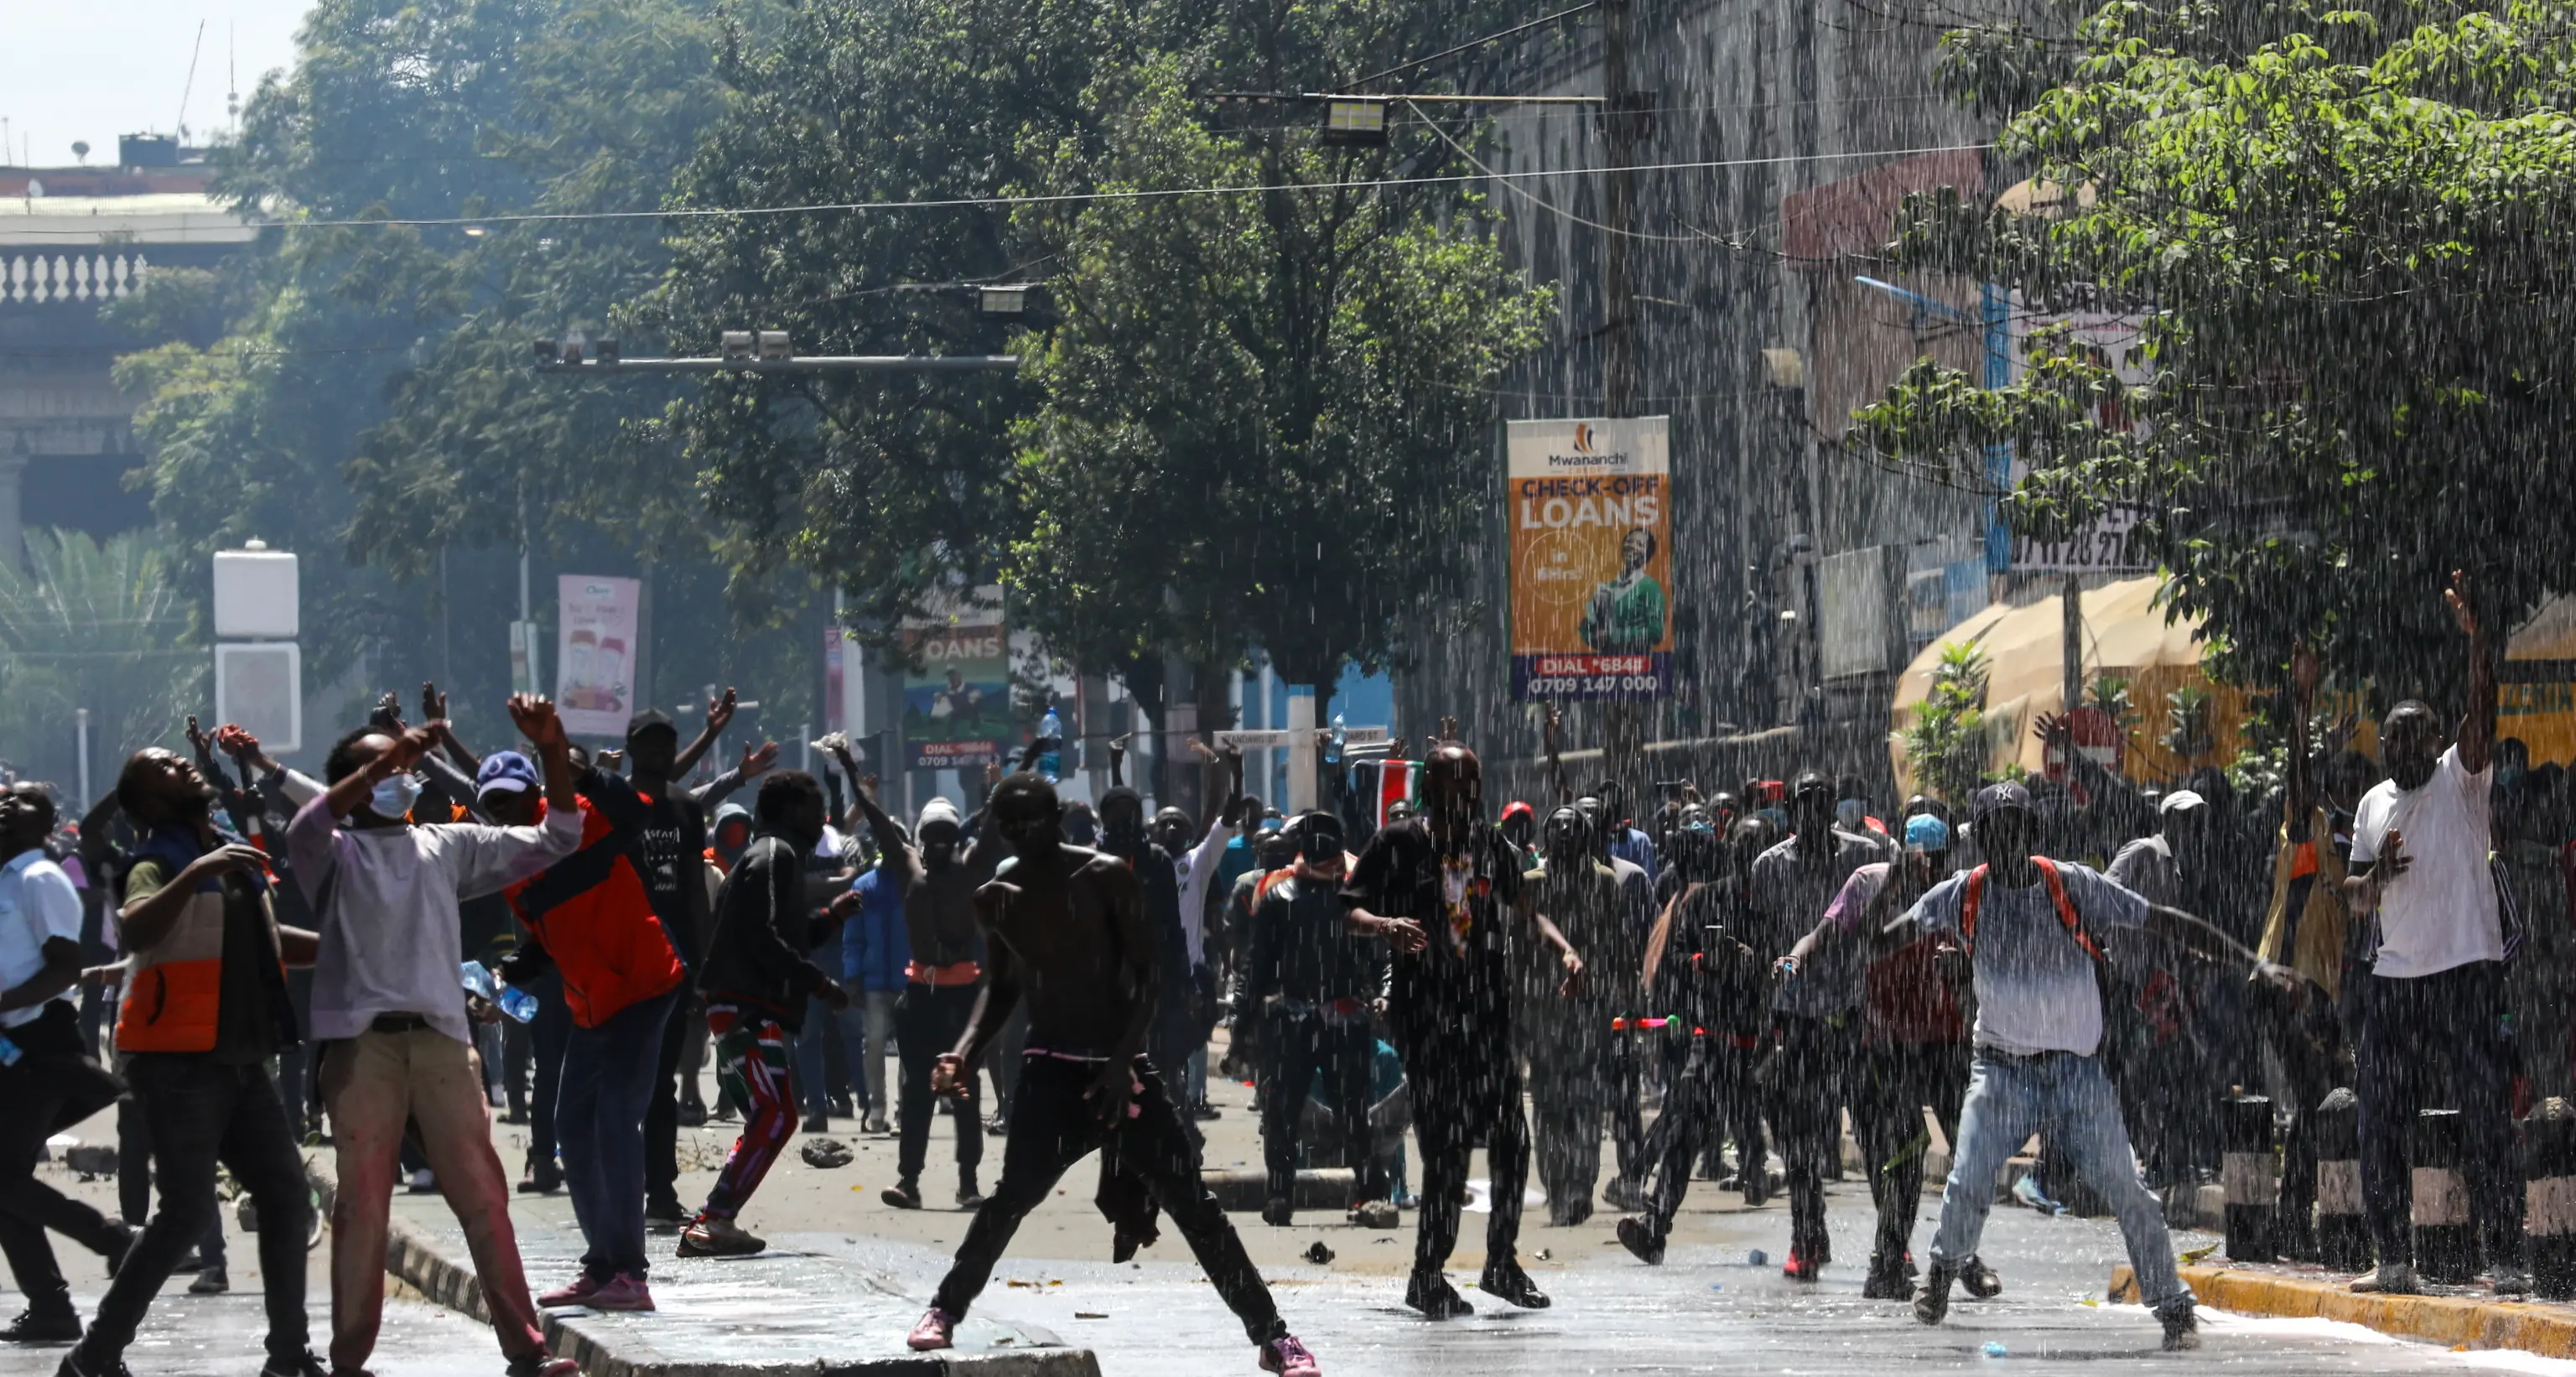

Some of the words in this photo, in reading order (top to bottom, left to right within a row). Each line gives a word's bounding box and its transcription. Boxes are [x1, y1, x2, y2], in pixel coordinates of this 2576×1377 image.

[1549, 453, 1627, 466] Mwananchi
[1522, 475, 1659, 496] CHECK-OFF
[1521, 495, 1659, 530] LOANS
[1552, 548, 1568, 563] in
[925, 637, 1000, 660] OANS
[1541, 659, 1587, 673] DIAL
[1530, 678, 1577, 694] 0709
[1584, 676, 1617, 692] 147
[1623, 675, 1658, 691] 000
[926, 744, 953, 755] DIAL
[918, 756, 948, 766] 0709
